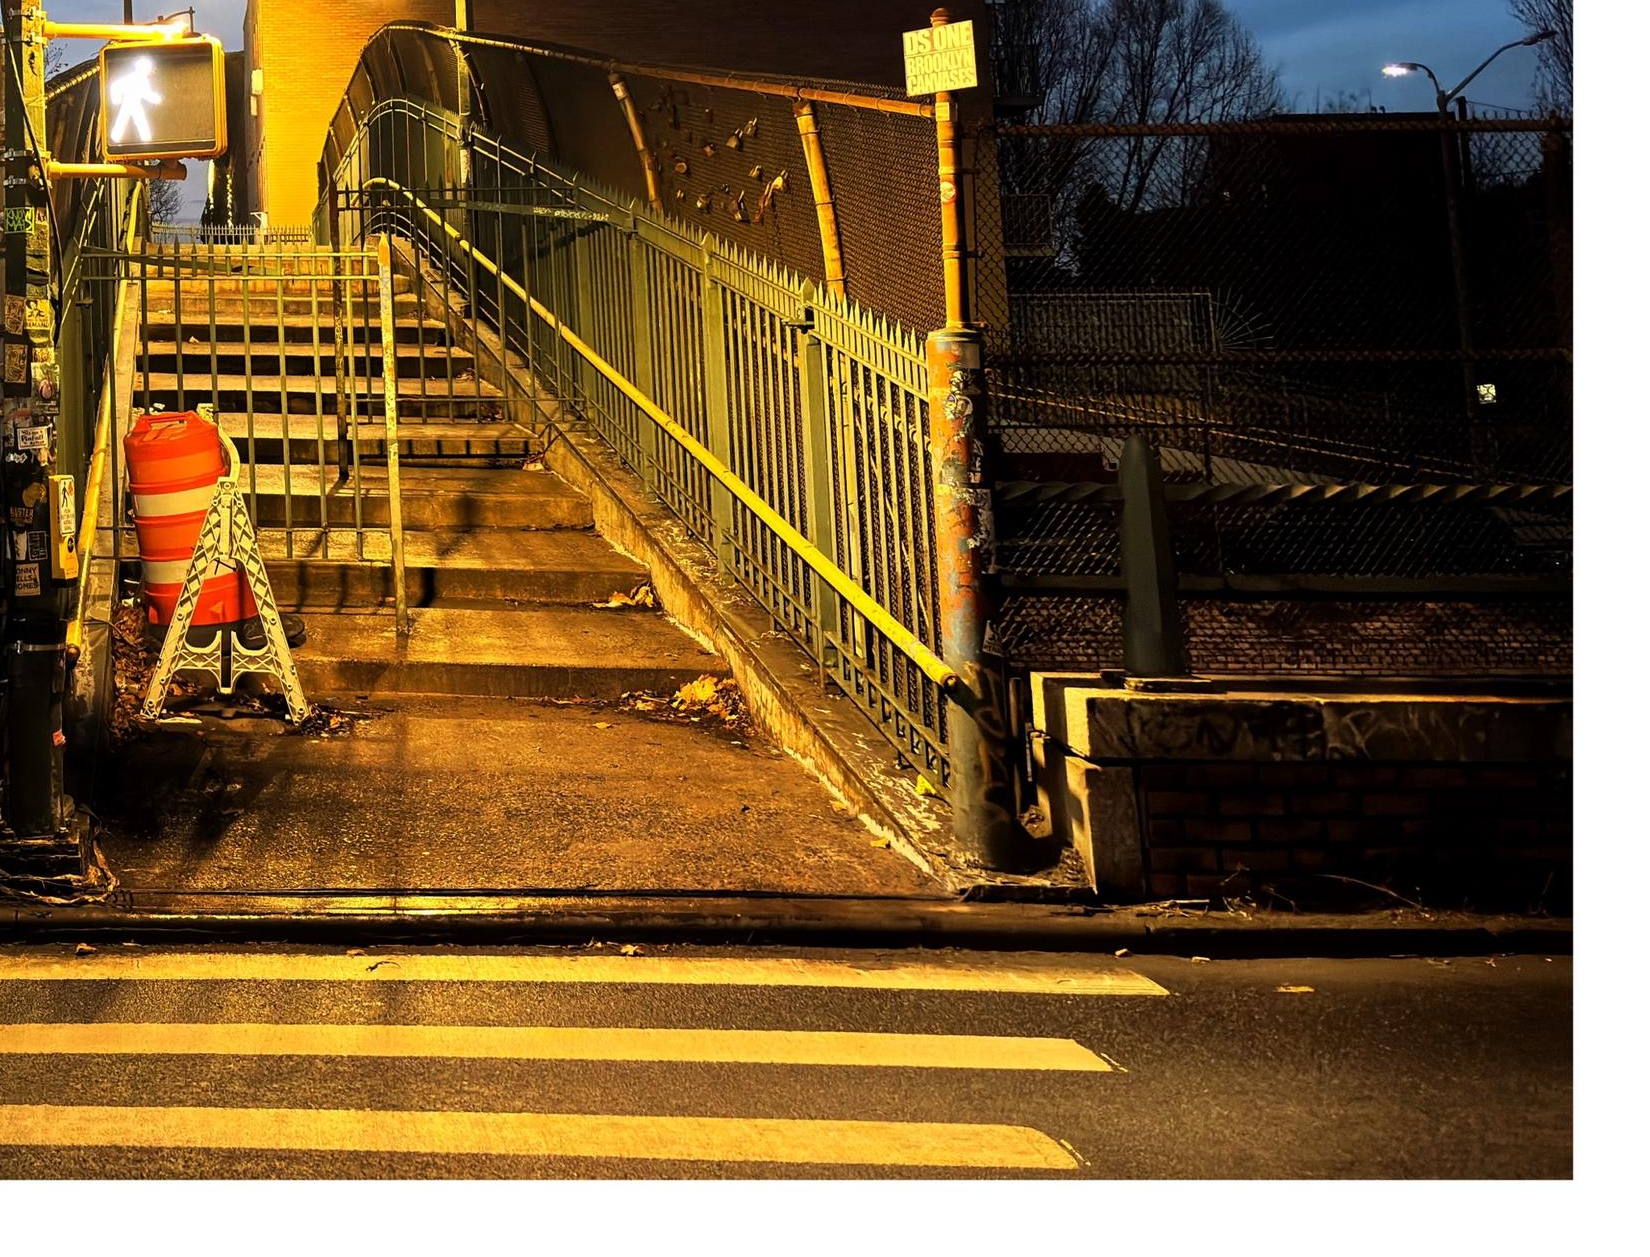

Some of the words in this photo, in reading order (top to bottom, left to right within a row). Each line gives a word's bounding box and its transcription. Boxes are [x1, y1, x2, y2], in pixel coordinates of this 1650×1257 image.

[932, 23, 973, 52] ONE
[906, 48, 974, 77] BROOKLYN
[907, 68, 975, 96] CANVASES
[15, 566, 38, 575] ONNY
[16, 574, 34, 582] ELLS
[15, 581, 39, 590] OMES
